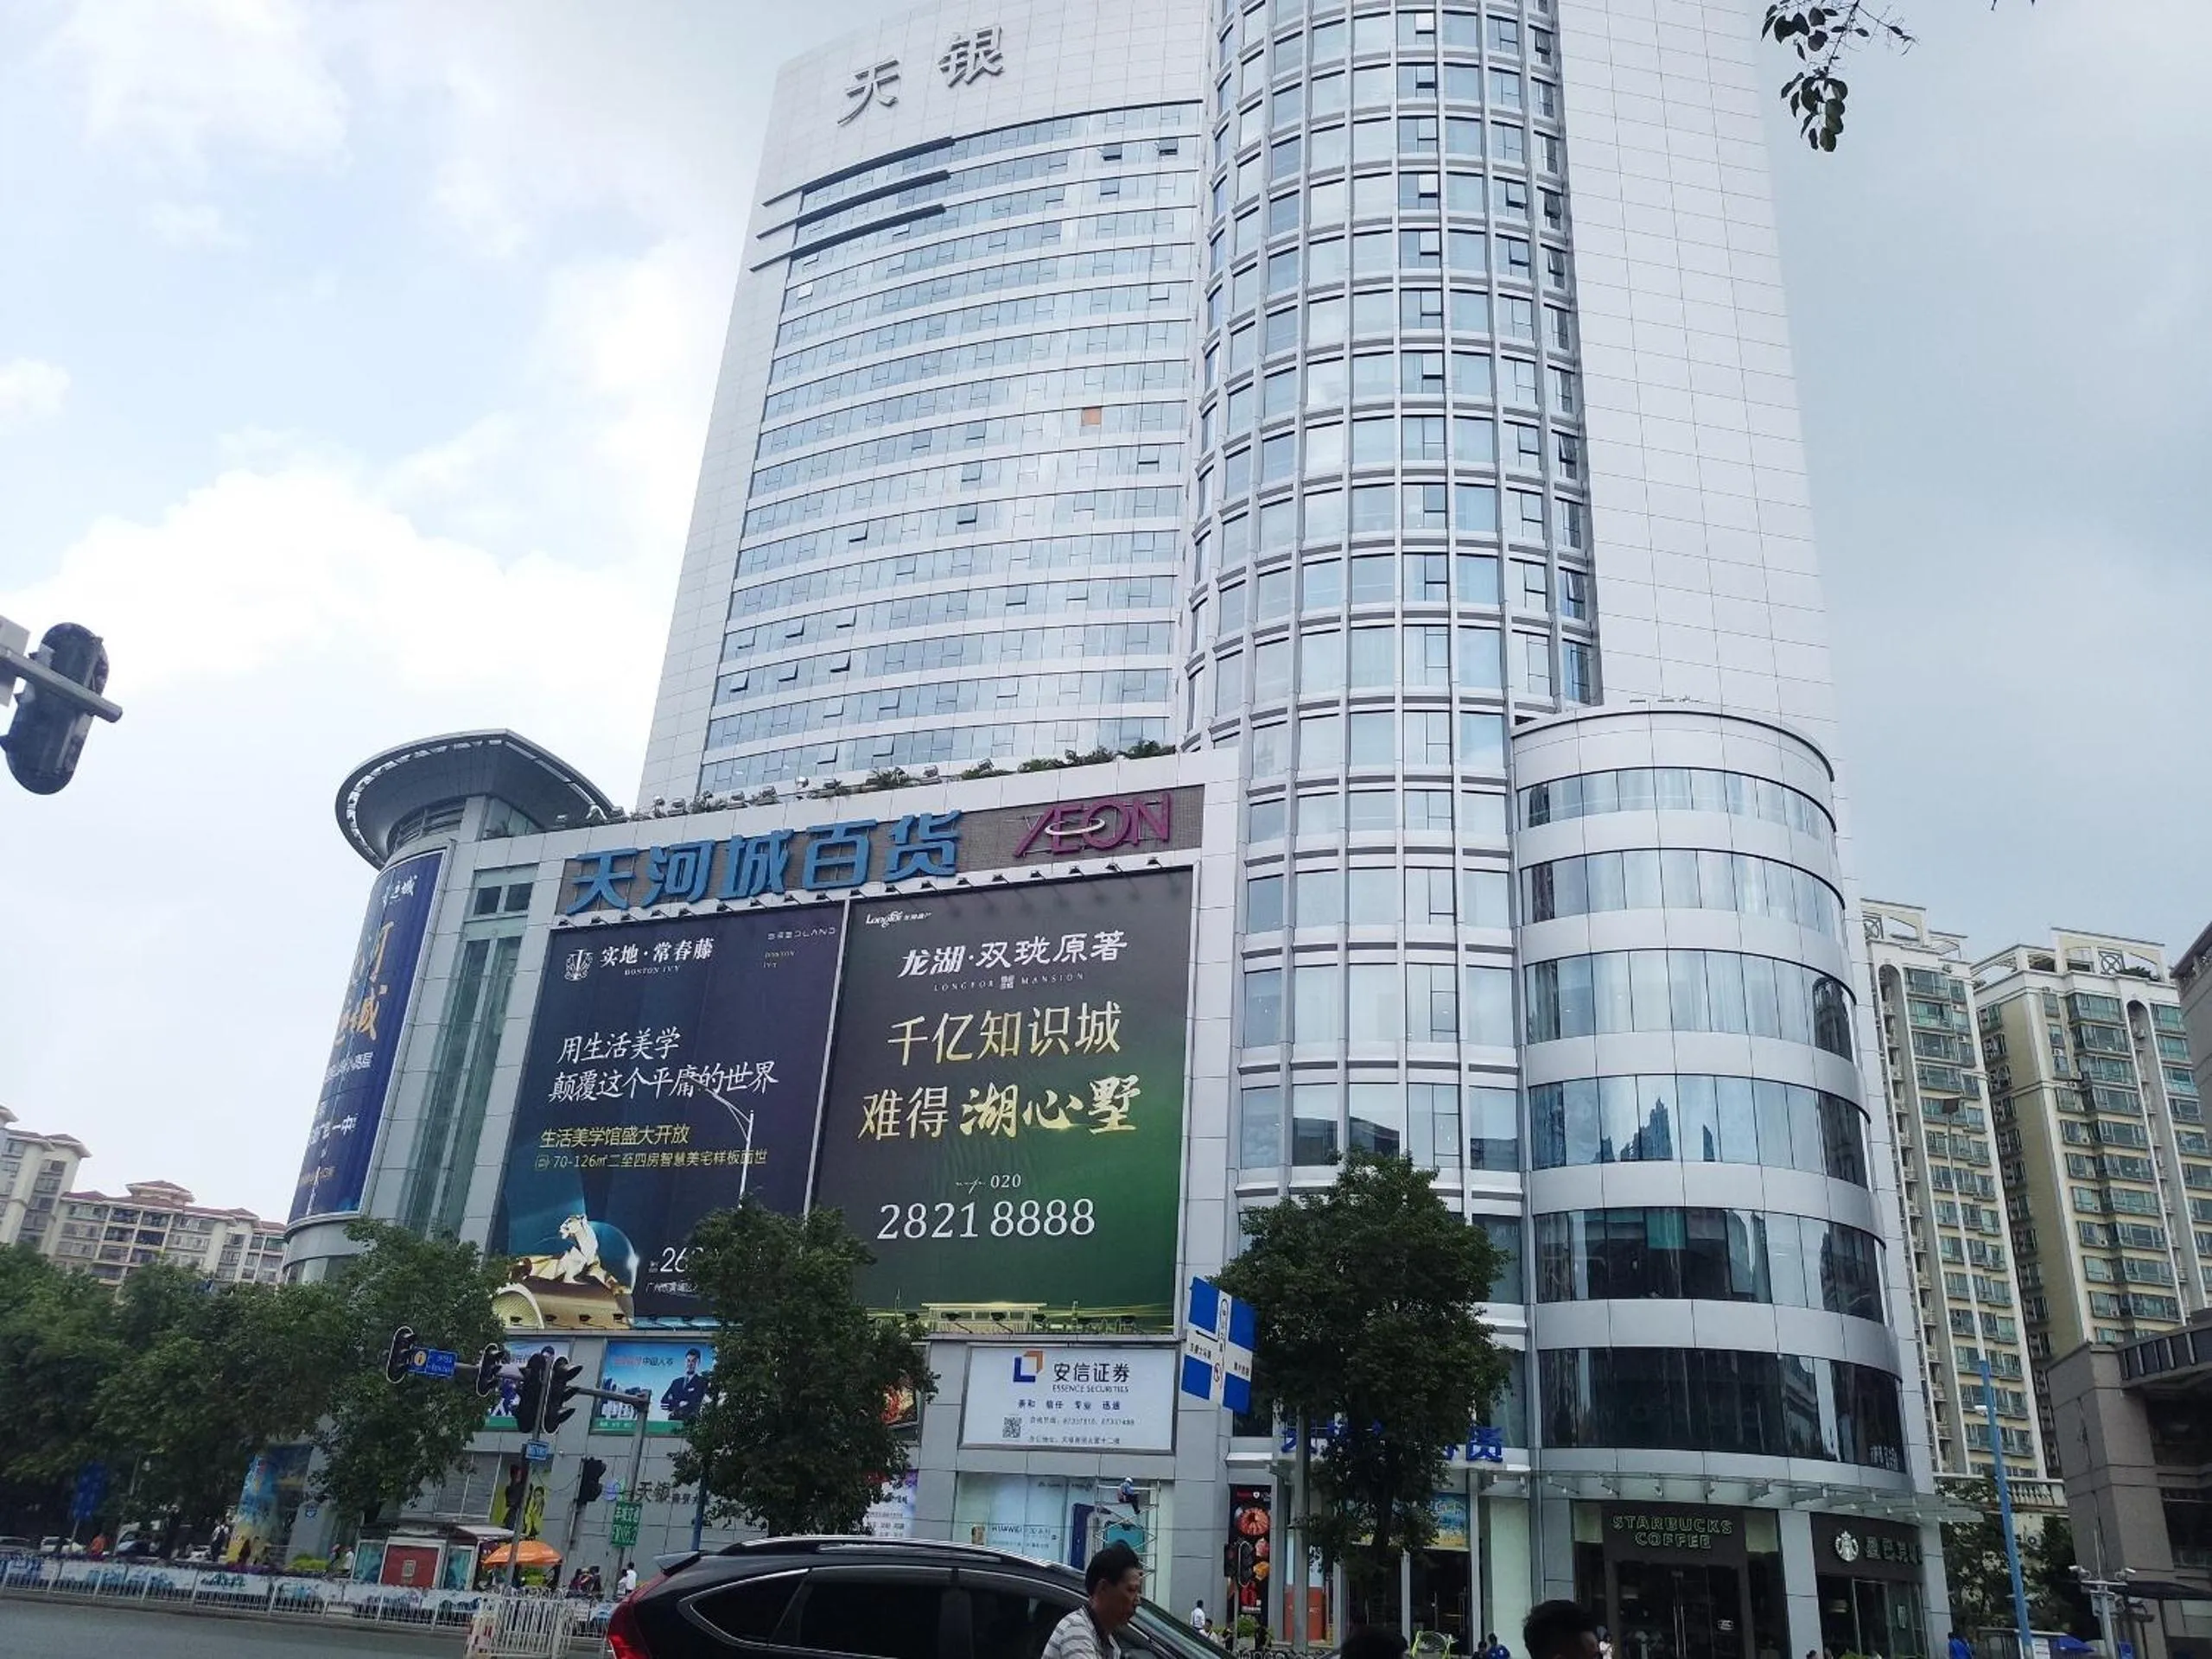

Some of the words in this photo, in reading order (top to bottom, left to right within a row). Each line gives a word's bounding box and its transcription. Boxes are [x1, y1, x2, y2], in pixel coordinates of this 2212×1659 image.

[836, 24, 1004, 125] 天银
[566, 809, 962, 915] 天河城百货
[556, 1026, 682, 1065] 用生活美学
[887, 1001, 1122, 1066] 千亿知识城
[548, 1060, 779, 1103] 颠覆这个平庸的世界
[857, 1074, 1141, 1141] 难得湖心墅
[539, 1123, 691, 1149] 生活美学馆盛大开放
[990, 1173, 1021, 1189] 020
[1053, 1362, 1130, 1382] 安信证券
[1611, 1515, 1733, 1535] STARBUCKS
[1635, 1532, 1712, 1549] COFFEE
